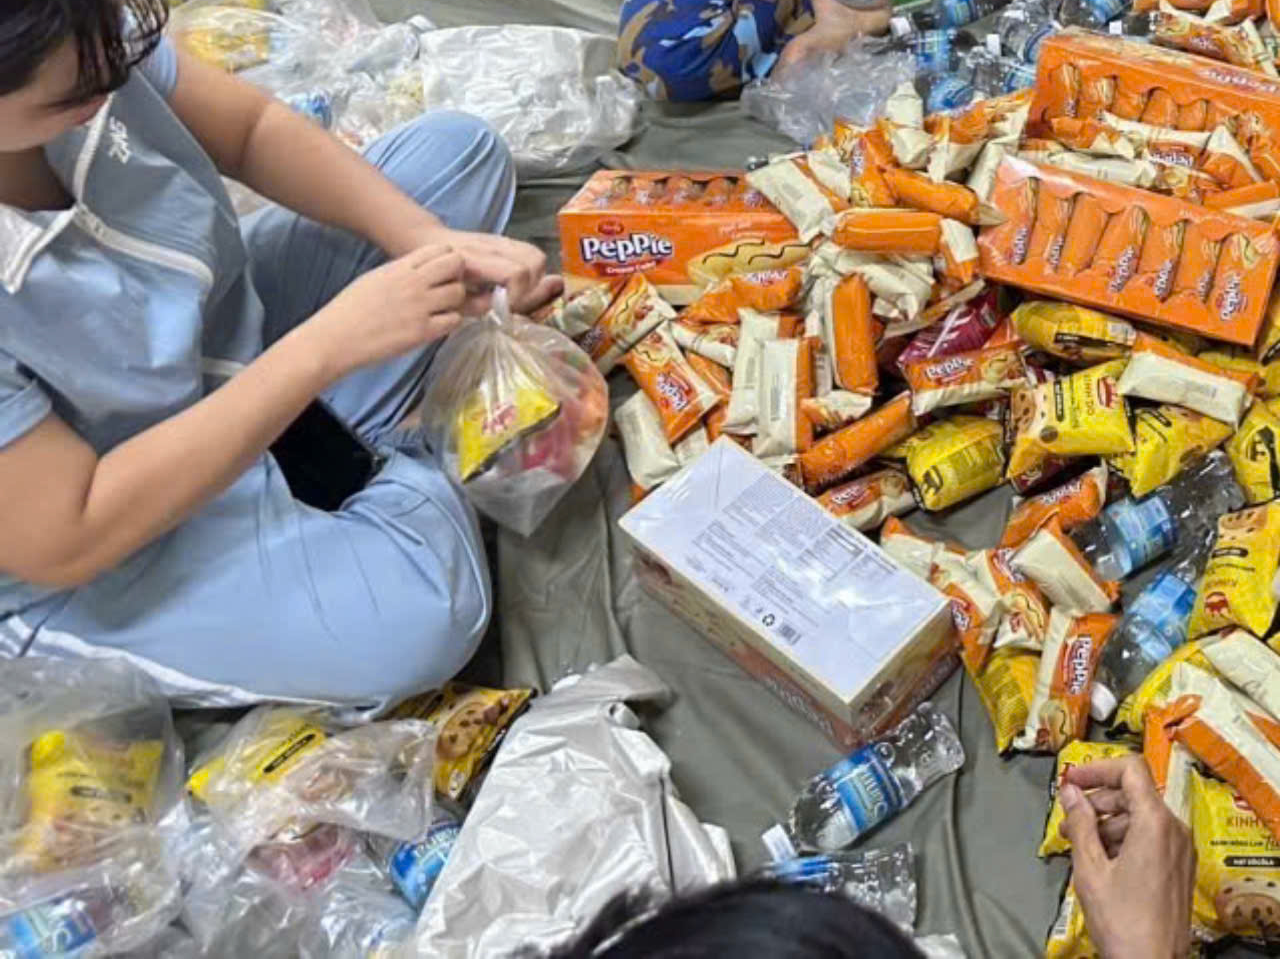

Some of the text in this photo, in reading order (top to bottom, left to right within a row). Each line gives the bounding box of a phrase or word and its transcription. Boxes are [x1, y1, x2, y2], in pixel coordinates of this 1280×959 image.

[579, 232, 675, 265] PepPie
[925, 356, 975, 380] PepPie
[1069, 633, 1094, 695] PepPie
